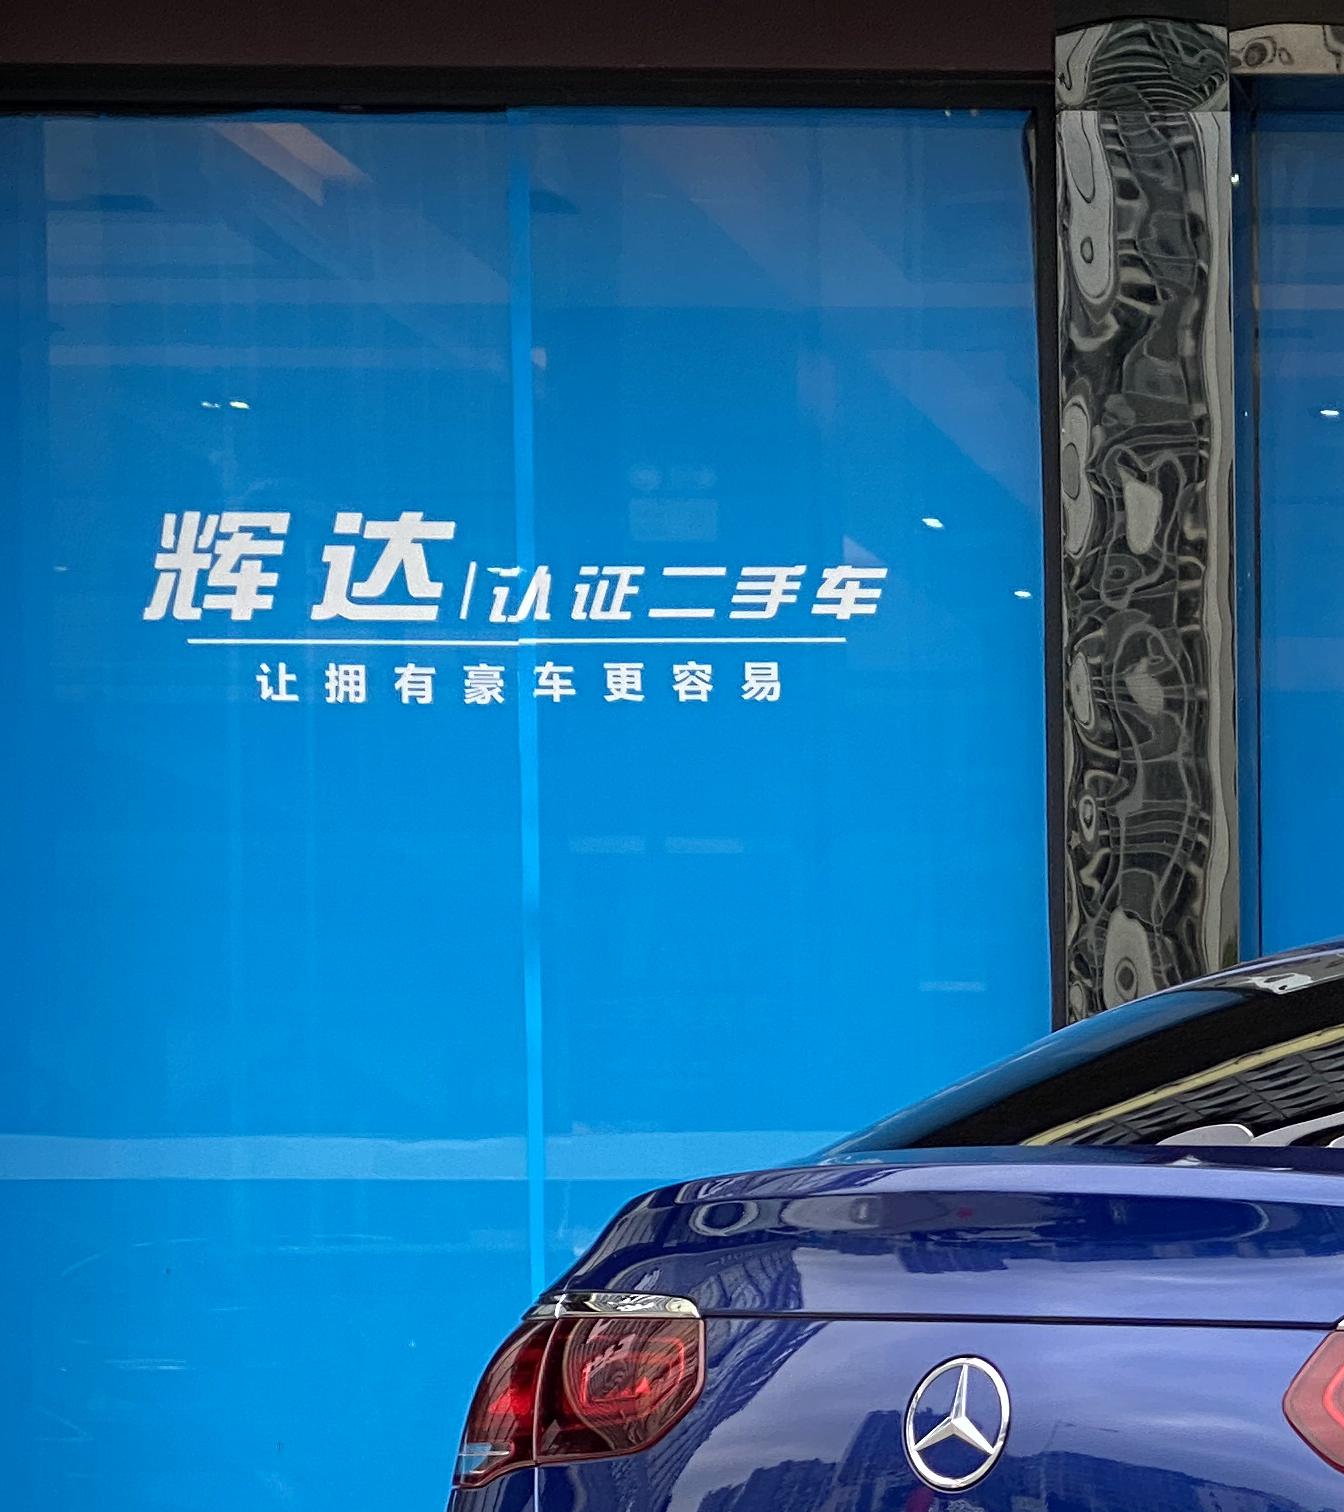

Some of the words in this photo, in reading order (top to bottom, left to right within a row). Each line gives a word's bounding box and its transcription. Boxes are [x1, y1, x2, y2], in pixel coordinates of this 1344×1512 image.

[255, 660, 781, 705] 让拥有豪车更容易
